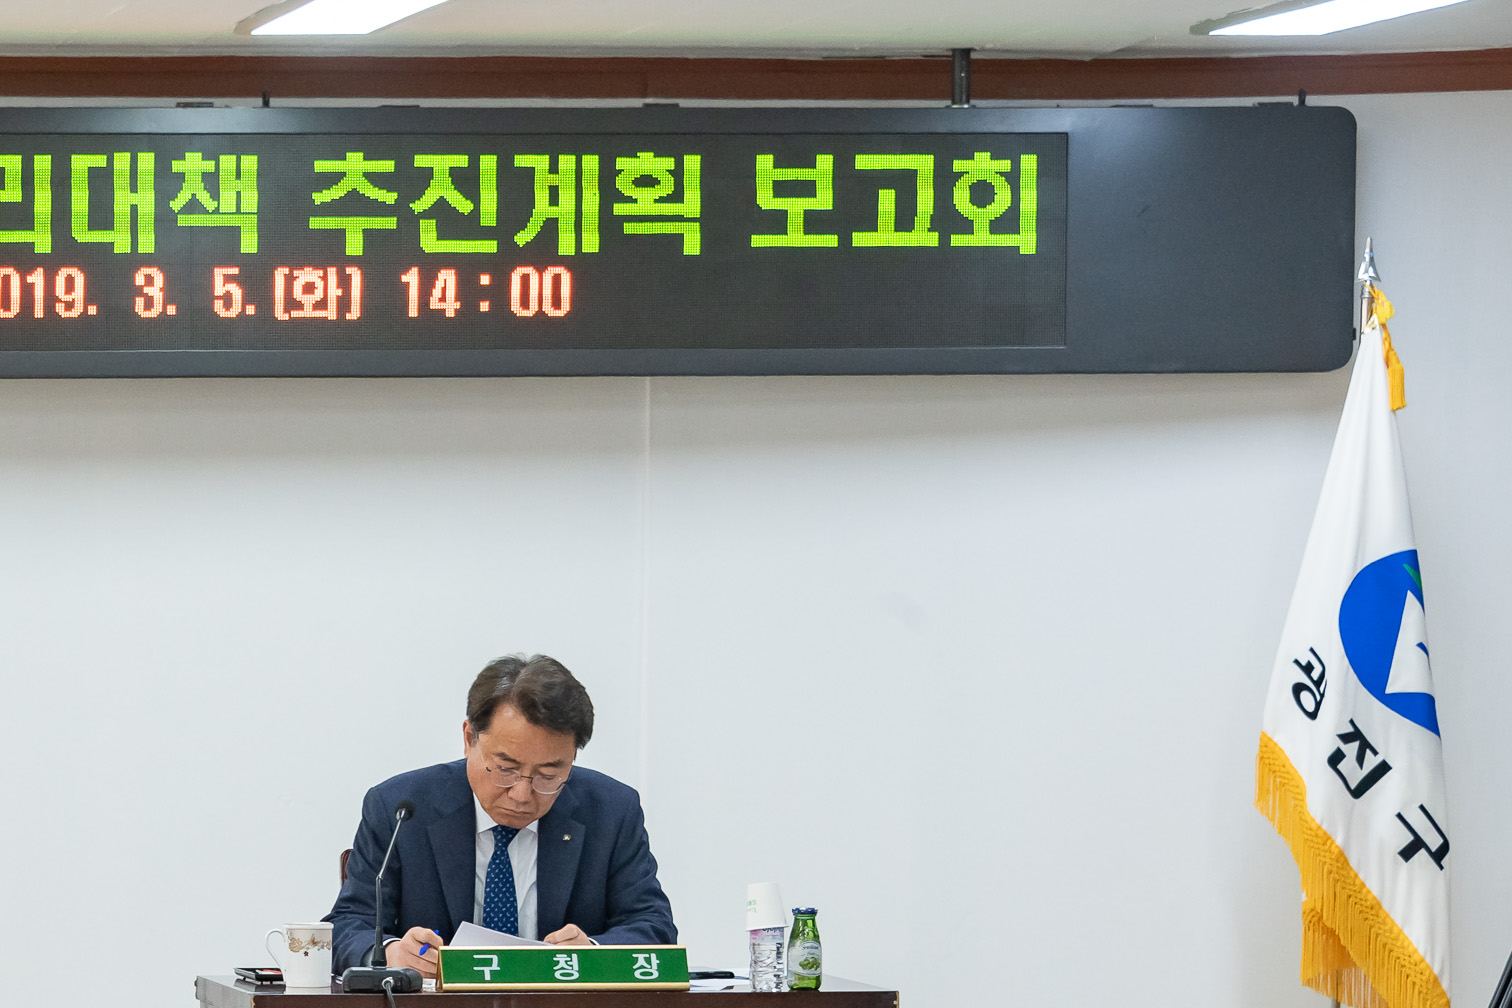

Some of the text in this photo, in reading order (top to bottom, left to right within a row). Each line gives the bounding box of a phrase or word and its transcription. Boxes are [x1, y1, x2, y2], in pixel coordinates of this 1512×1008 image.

[308, 151, 702, 256] 추진계획
[750, 151, 1038, 255] 보고회
[133, 266, 177, 319] 3.
[1291, 646, 1451, 872] 광진구
